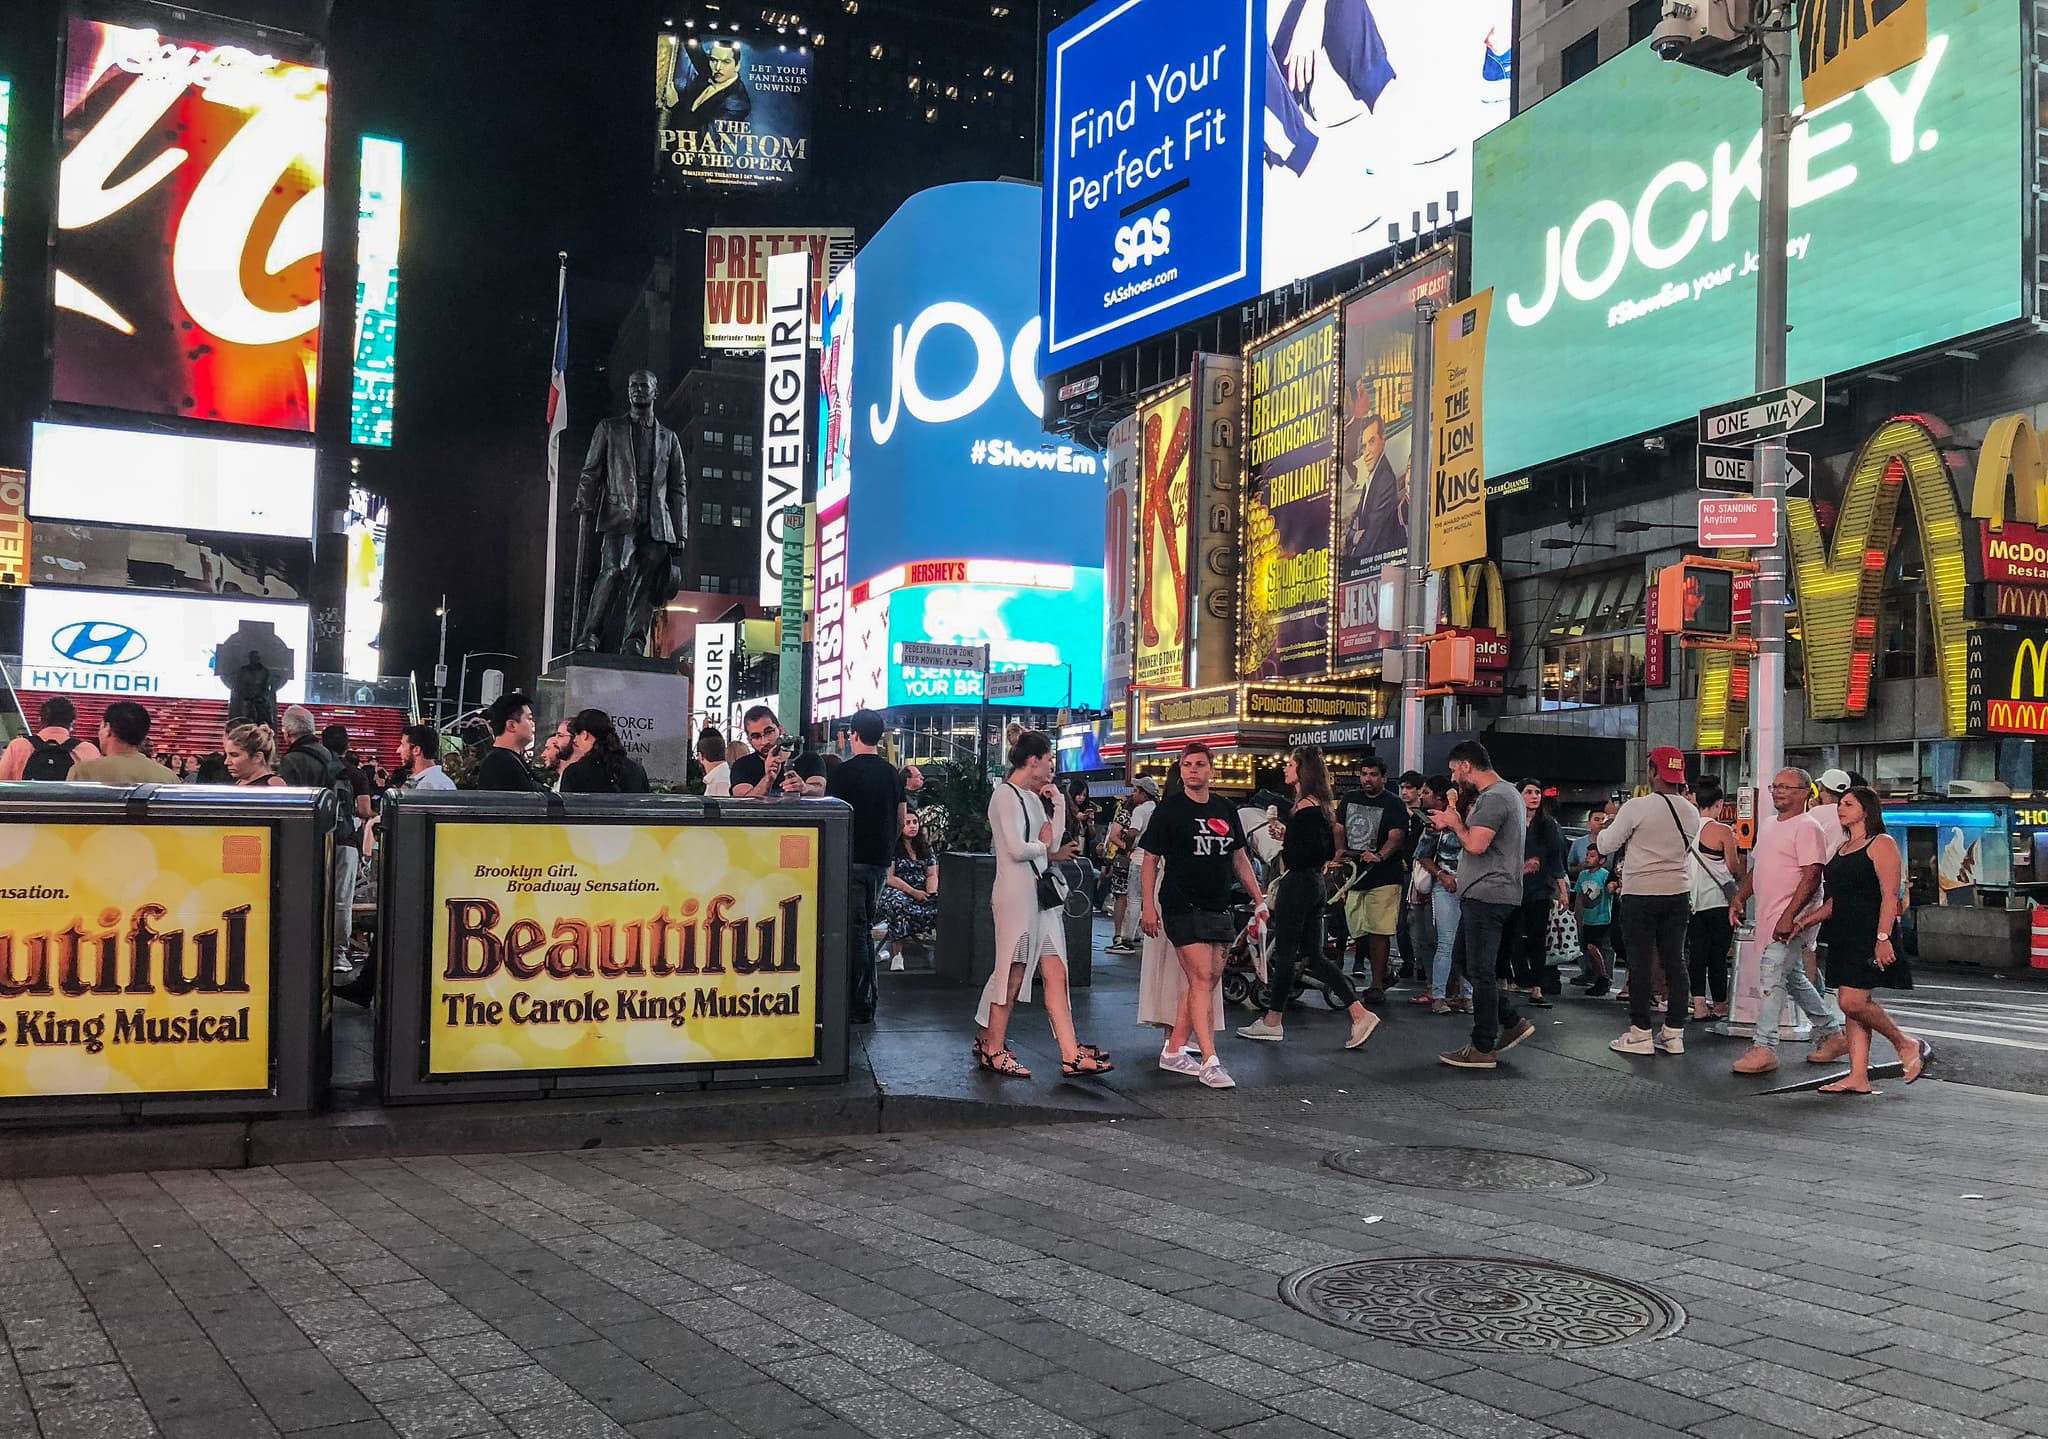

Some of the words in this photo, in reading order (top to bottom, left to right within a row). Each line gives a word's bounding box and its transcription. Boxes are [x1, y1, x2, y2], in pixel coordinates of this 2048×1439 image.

[749, 73, 808, 84] FANTASIES
[751, 64, 772, 73] LET
[776, 66, 807, 75] YOUR
[755, 82, 801, 93] UNWIND
[1071, 80, 1136, 158] Find
[1146, 44, 1226, 113] Your
[714, 119, 752, 134] THE
[658, 129, 808, 160] PHANTOM
[671, 151, 695, 166] OF
[698, 153, 734, 168] THE
[736, 155, 794, 172] OPERA
[1068, 135, 1174, 219] Perfect
[1185, 108, 1226, 161] Fit
[1112, 208, 1171, 273] SAS
[1103, 267, 1178, 308] SASshoes.com
[1693, 263, 1736, 300] your
[1253, 356, 1270, 397] AN
[1273, 324, 1333, 387] INSPIRED
[1252, 364, 1333, 436] BROADWAY
[1373, 378, 1402, 424] TALE
[1444, 387, 1470, 418] THE
[1716, 411, 1750, 436] ONE
[1766, 398, 1803, 424] WAY
[765, 287, 803, 582] COVERGIRL
[1251, 408, 1331, 467] EXTRAVAGANZA!
[1440, 421, 1474, 466] LION
[970, 438, 1096, 475] #ShowEm
[1714, 460, 1746, 479] ONE
[1208, 374, 1236, 619] PALACE
[1270, 457, 1330, 509] BRILLIANT!
[1435, 467, 1480, 518] KING
[1703, 504, 1716, 514] NO
[1718, 503, 1758, 514] STANDING
[1703, 514, 1738, 525] Anytime
[911, 562, 966, 583] HERSHEY'S
[1360, 556, 1373, 566] NOW
[1374, 554, 1383, 562] ON
[781, 541, 803, 653] EXPERIENCE
[1341, 579, 1380, 629] JERS
[904, 644, 941, 655] PEDESTRIAN
[942, 646, 958, 656] FLOW
[959, 646, 974, 657] ZONE
[904, 655, 919, 664] KEEP
[33, 670, 158, 693] HYUNDAI
[905, 681, 949, 697] YOUR
[611, 716, 654, 730] EORGE
[1288, 730, 1328, 747] CHANGE
[1329, 726, 1367, 743] MONEY
[1371, 724, 1395, 740] ATM
[1193, 836, 1235, 856] NY
[474, 864, 544, 881] Brooklyn
[547, 864, 579, 879] Girl.
[506, 878, 582, 896] Broadway
[584, 878, 661, 893] Sensation.
[443, 894, 803, 982] Beautiful
[442, 991, 504, 1028] The
[508, 989, 611, 1026] Carole
[615, 989, 688, 1029] King
[692, 984, 802, 1020] Musical
[15, 1010, 106, 1055] King
[112, 1006, 251, 1046] Musical
